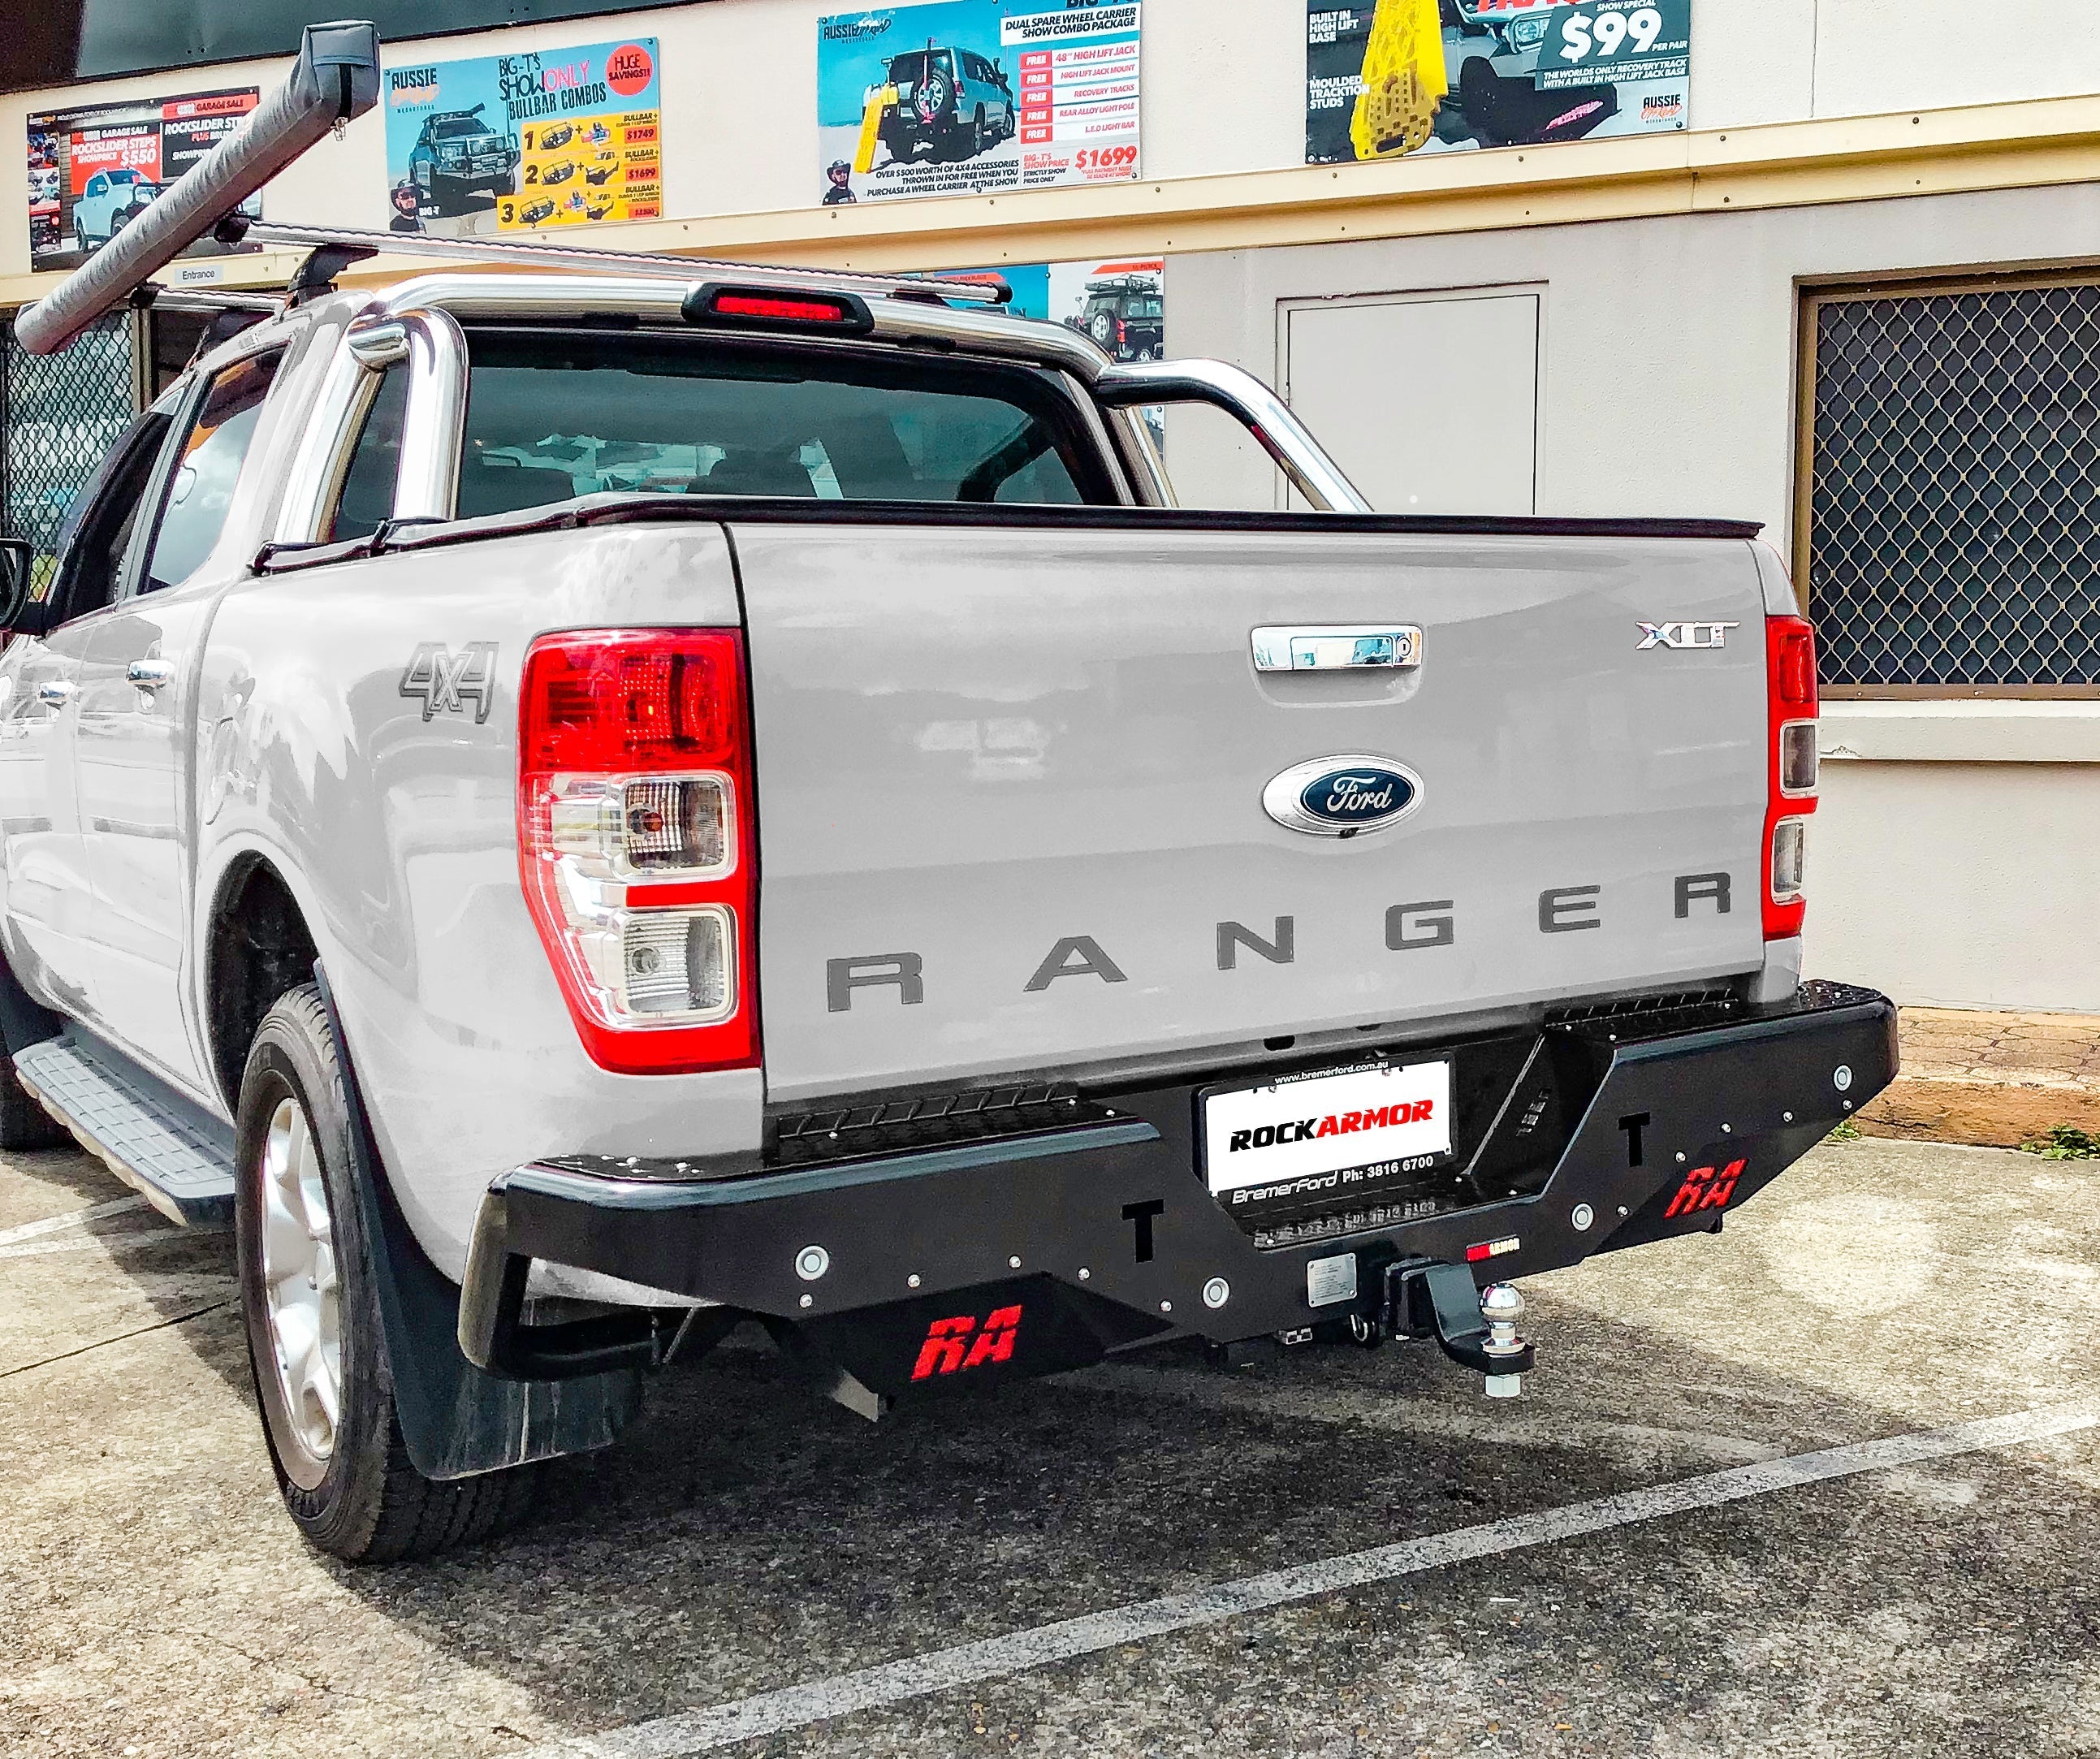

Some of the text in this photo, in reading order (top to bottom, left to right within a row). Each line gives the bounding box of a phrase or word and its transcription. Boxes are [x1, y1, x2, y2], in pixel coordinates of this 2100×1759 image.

[1597, 1, 1623, 11] SHOW
[1005, 7, 1136, 31] DUAL SPARE WHEEL CARRIER
[1309, 9, 1350, 24] BUILT IN
[1310, 19, 1359, 33] HIGH LIFT
[1022, 17, 1135, 38] SHOW COMBO PACKAGE
[1309, 31, 1336, 44] BASE
[1558, 8, 1662, 63] $99
[1026, 55, 1047, 66] FREE
[1074, 50, 1095, 60] HIGH
[1096, 48, 1114, 58] LIFT
[1113, 45, 1136, 55] JACK
[1652, 40, 1688, 52] PER PAIR
[391, 68, 437, 90] AUSSIE
[1026, 64, 1135, 84] FREE HIGH LIFT JACK MOUNT
[1543, 79, 1565, 89] WITH
[1572, 75, 1594, 85] BUILT
[1594, 74, 1604, 82] IN
[1605, 72, 1626, 82] HIGH
[1627, 71, 1643, 80] LIFT
[1641, 69, 1665, 79] JACK
[1665, 67, 1686, 76] BASE
[1544, 58, 1687, 80] THE WORLDS ONLY RECOVERY TRACK
[499, 59, 590, 101] SHOW ONLY
[1309, 76, 1363, 89] MOULDED
[509, 81, 607, 120] BULLBAR COMBOS
[1026, 84, 1134, 102] FREE RECOVERY TRACKS
[1310, 84, 1370, 99] TRACKTION
[1644, 93, 1680, 109] AUSSIE
[197, 101, 225, 111] GARAGE
[227, 99, 243, 108] SALE
[1026, 102, 1134, 121] FREE REAR ALLOY LIGHT POLE
[1310, 97, 1344, 110] STUDS
[102, 127, 130, 138] GARAGE
[131, 126, 148, 136] SALE
[165, 118, 224, 135] ROCKSLIDER
[627, 129, 654, 140] $1749
[1026, 129, 1046, 139] FREE
[1102, 123, 1121, 132] LIGHT
[1121, 121, 1134, 129] BAR
[71, 136, 157, 156] ROCKSLIDER STEPS
[191, 132, 210, 142] PLUS
[524, 130, 534, 150] 1
[120, 149, 156, 167] $550
[1023, 158, 1069, 170] SHOW PRICE
[1074, 145, 1137, 170] $1699
[525, 164, 538, 184] 2
[876, 171, 894, 179] OVER
[915, 166, 942, 175] WORTH
[944, 165, 953, 173] OF
[970, 160, 1019, 171] ACCESSORIES
[902, 175, 935, 184] THROWN
[944, 173, 960, 181] FOR
[961, 172, 977, 180] FREE
[979, 171, 1001, 179] WHEN
[1002, 168, 1018, 176] YOU
[866, 188, 904, 197] PURCHASE
[911, 184, 935, 192] WHEEL
[937, 182, 967, 190] CARRIER
[995, 177, 1019, 186] SHOW
[500, 203, 514, 223] 3
[182, 270, 214, 280] Entrance
[1635, 621, 1740, 650] XLT
[1326, 776, 1393, 812] Ford
[827, 872, 1731, 1012] RANGER
[1275, 1061, 1389, 1084] www.bremerford.com.au
[1229, 1100, 1433, 1153] ROCKARMOR
[1342, 1170, 1363, 1183] Ph:
[1367, 1161, 1399, 1179] 3816
[1402, 1155, 1434, 1173] 6700
[1663, 1158, 1749, 1219] RA
[911, 1303, 1024, 1382] RA
